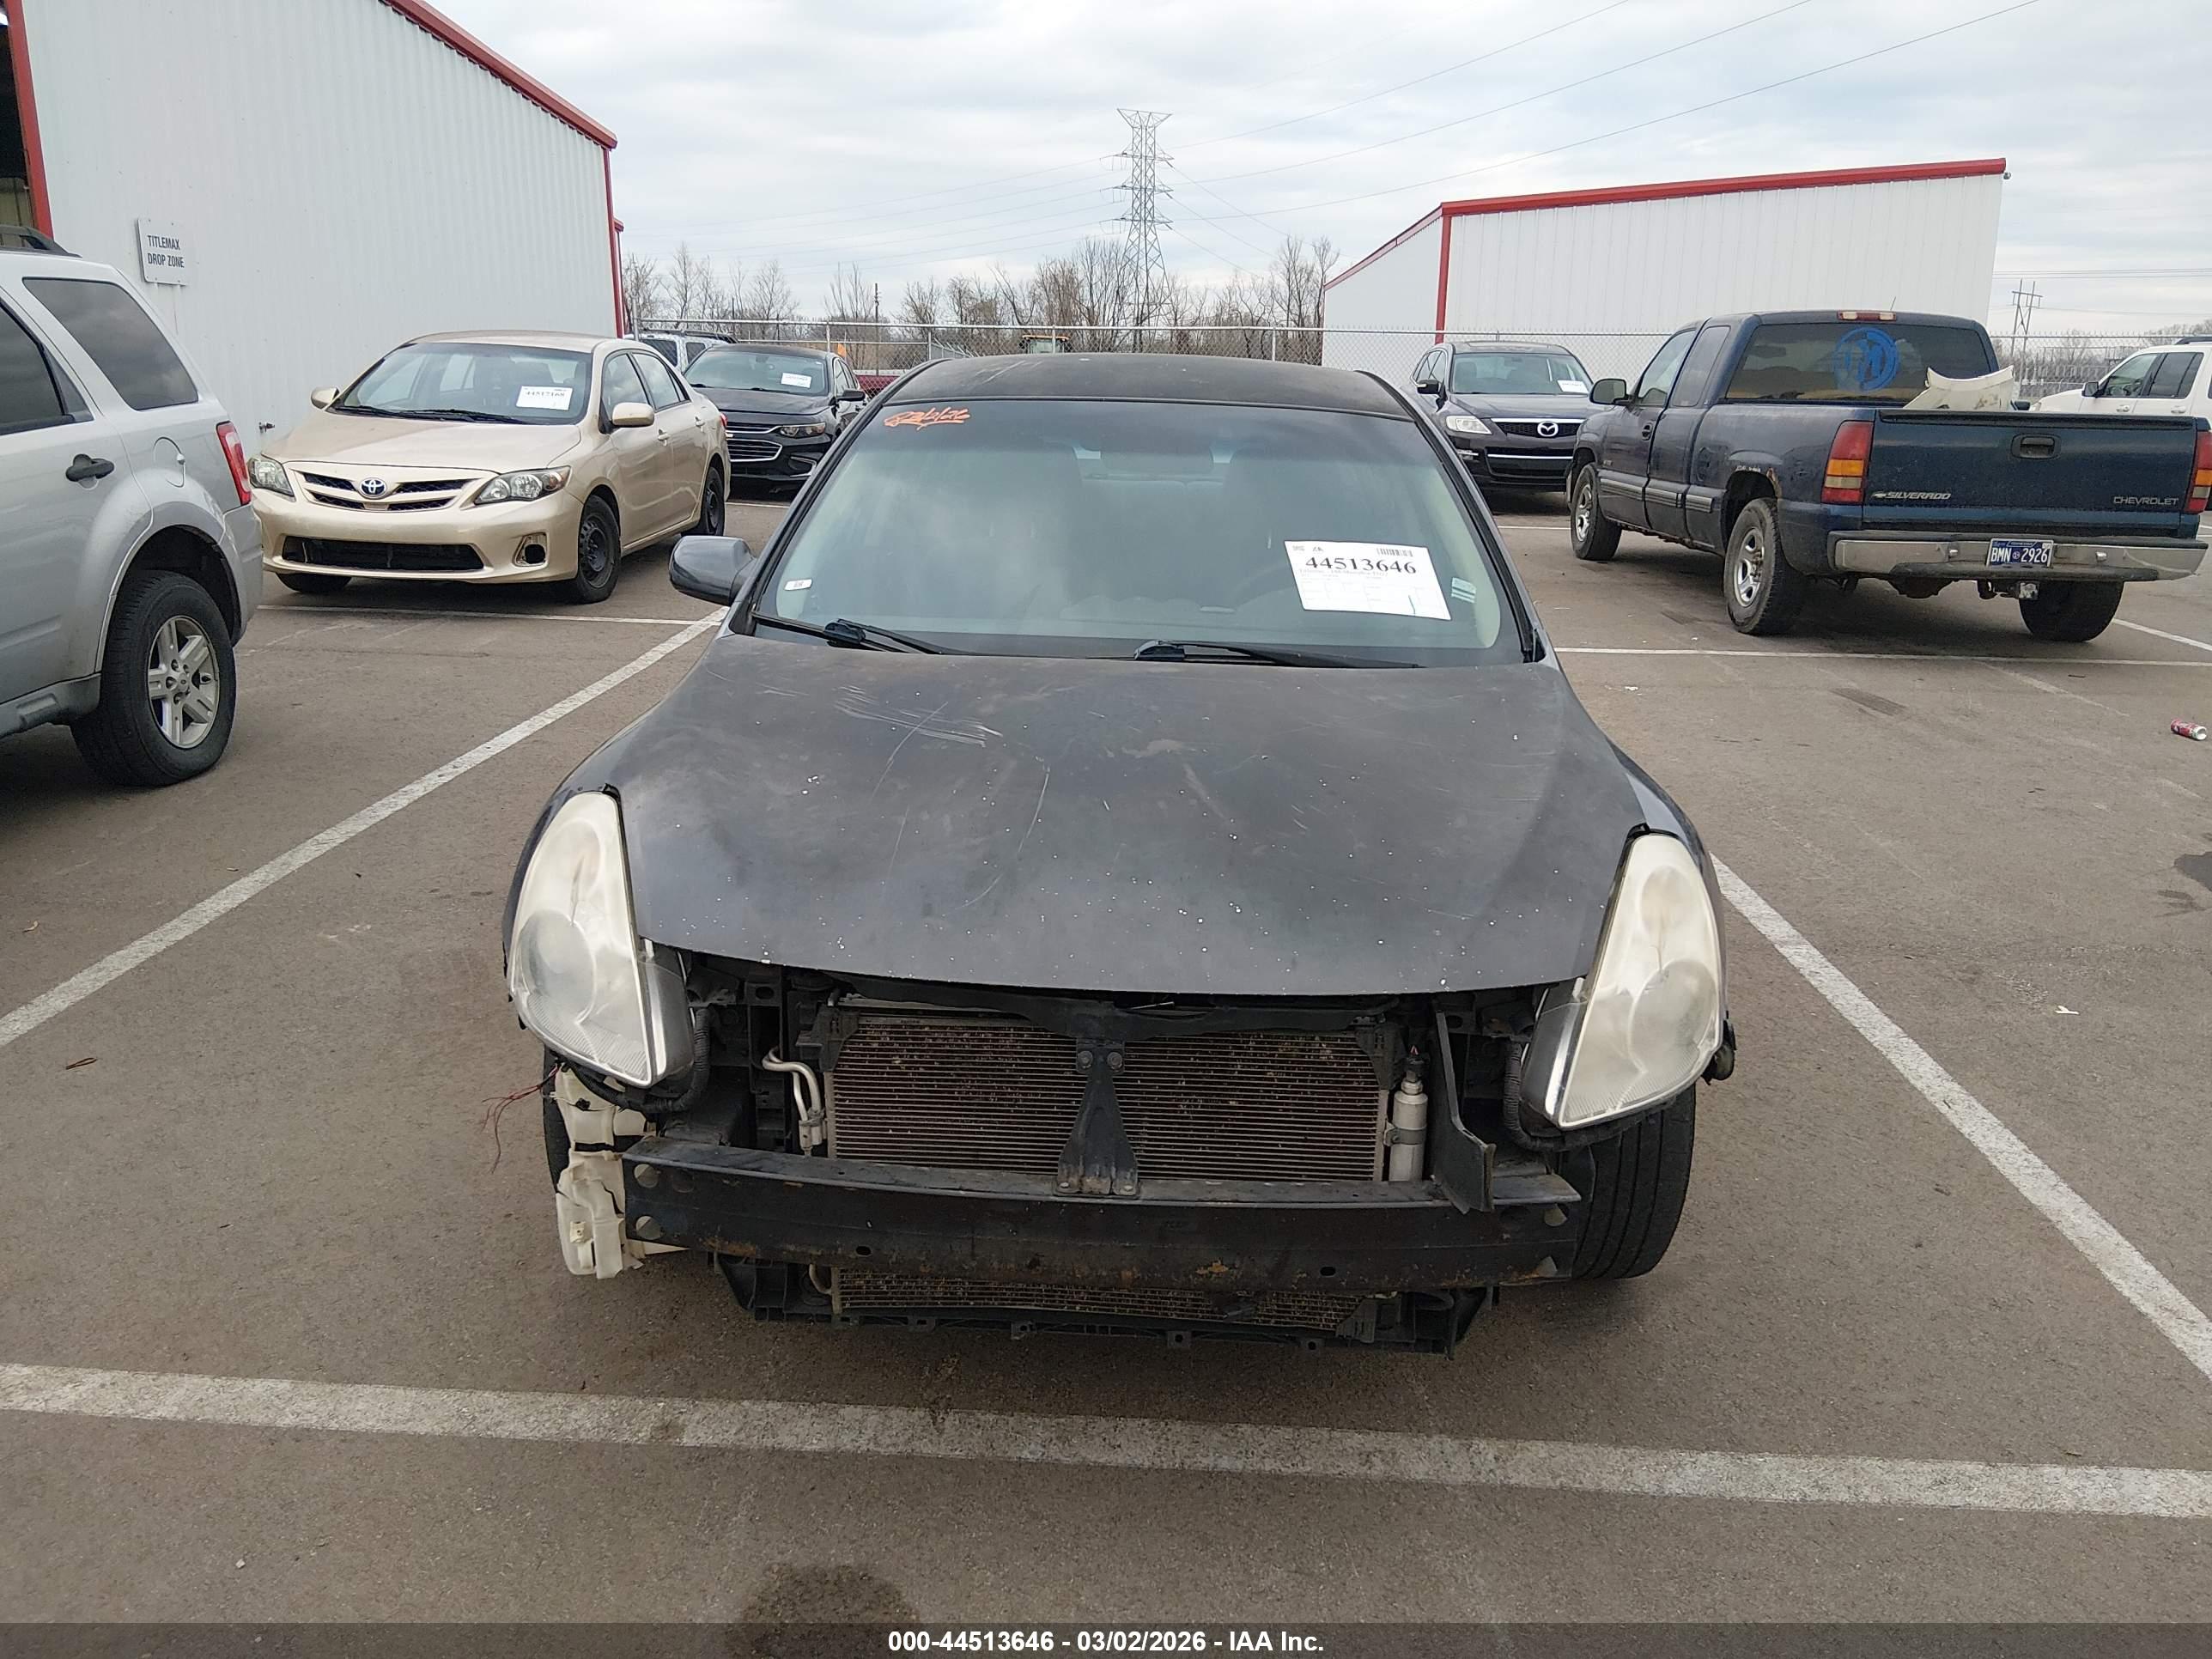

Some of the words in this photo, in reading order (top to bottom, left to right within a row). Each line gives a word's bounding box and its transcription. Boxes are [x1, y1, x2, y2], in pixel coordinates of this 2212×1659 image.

[147, 234, 180, 251] TITLEMAX
[147, 252, 167, 266] DROP
[167, 255, 185, 269] ZONE
[1885, 491, 1952, 500] SILVERADO
[2113, 496, 2179, 506] CHEVROLET
[1990, 547, 2012, 562] BMN
[2021, 548, 2048, 563] 2926
[1305, 556, 1417, 574] 44513646
